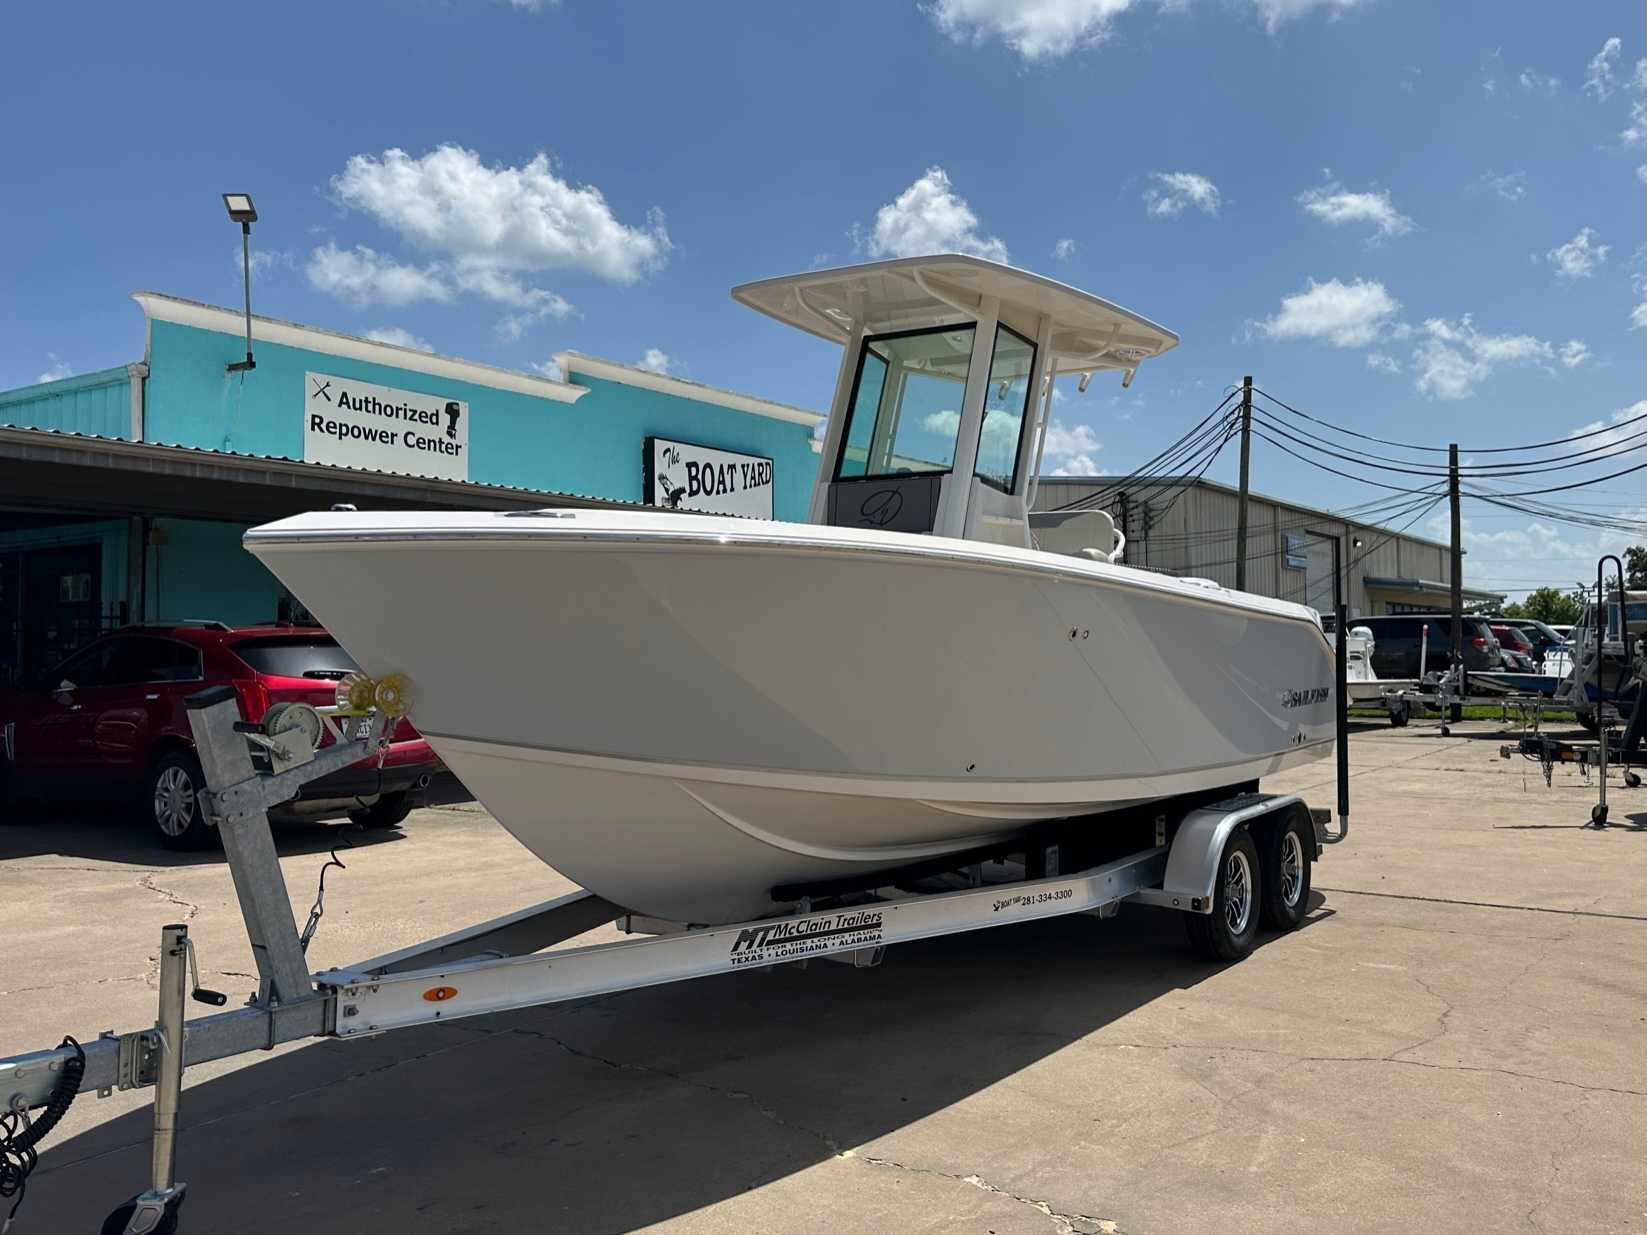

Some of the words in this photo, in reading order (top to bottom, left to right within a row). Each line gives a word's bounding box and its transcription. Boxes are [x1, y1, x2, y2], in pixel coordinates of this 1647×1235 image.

[337, 391, 440, 426] Authorized
[310, 414, 398, 445] Repower
[403, 431, 462, 456] Center
[662, 445, 681, 469] The
[685, 461, 737, 498] BOAT
[741, 461, 772, 490] YARD
[1022, 889, 1073, 906] 281-334-3300
[773, 918, 831, 938] McClain
[836, 911, 883, 928] Trailers
[730, 953, 764, 965] TEXAS
[775, 943, 829, 958] LOUISIANA
[839, 934, 883, 946] ALABAMA
